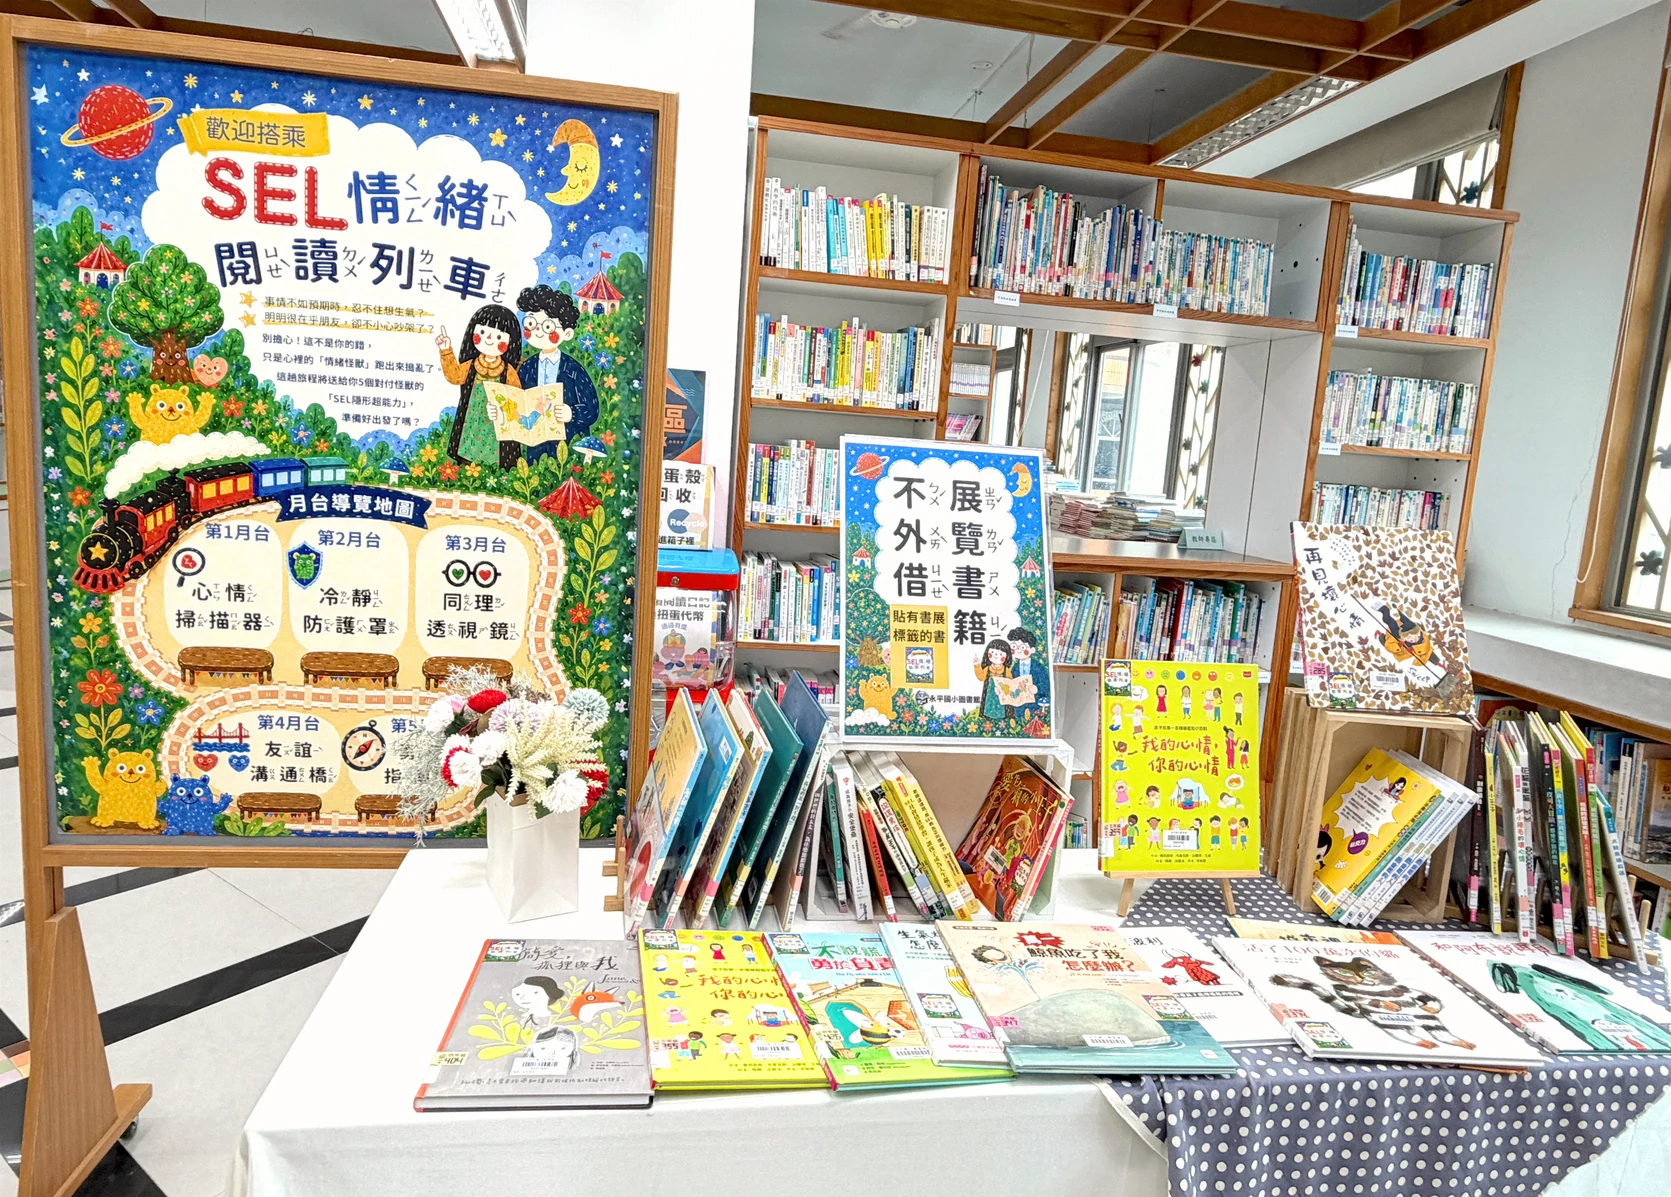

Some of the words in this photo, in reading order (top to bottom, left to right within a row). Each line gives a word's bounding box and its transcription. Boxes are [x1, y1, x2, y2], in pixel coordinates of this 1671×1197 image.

[206, 116, 305, 148] 歡迎搭乘
[341, 413, 420, 427] 準備好出發了嗎？
[289, 493, 415, 519] 月台導覽地圖
[669, 518, 707, 528] Recycle
[205, 523, 270, 542] 第1月台
[318, 530, 381, 549] 第2月台
[445, 535, 507, 553] 第3月台
[893, 610, 946, 625] 貼有書展
[893, 628, 946, 644] 標籤的書
[257, 714, 320, 732] 第4月台
[1148, 755, 1220, 777] 你的心情
[1026, 947, 1125, 960] 鯨魚吃了我
